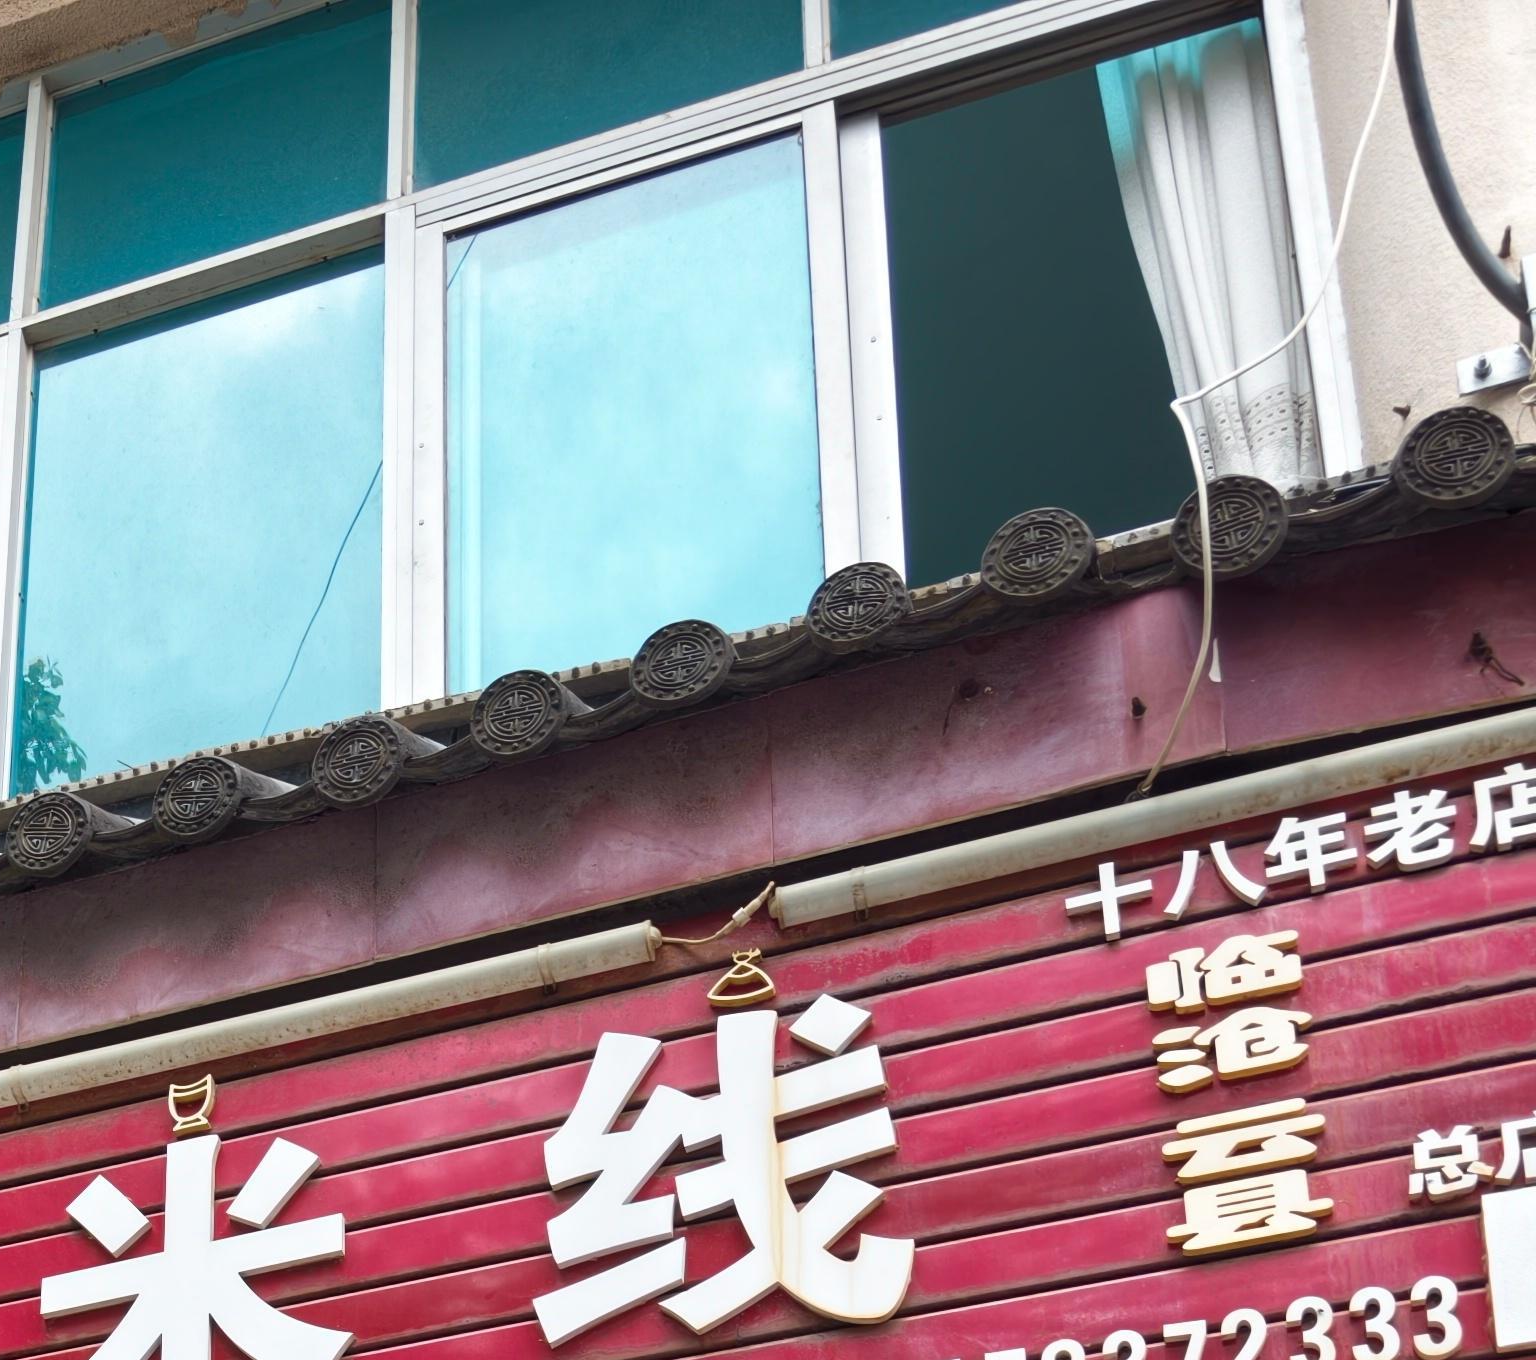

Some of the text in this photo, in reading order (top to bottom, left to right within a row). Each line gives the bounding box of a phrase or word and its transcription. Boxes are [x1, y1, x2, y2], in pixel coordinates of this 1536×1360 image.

[1064, 763, 1536, 941] 十八年老店
